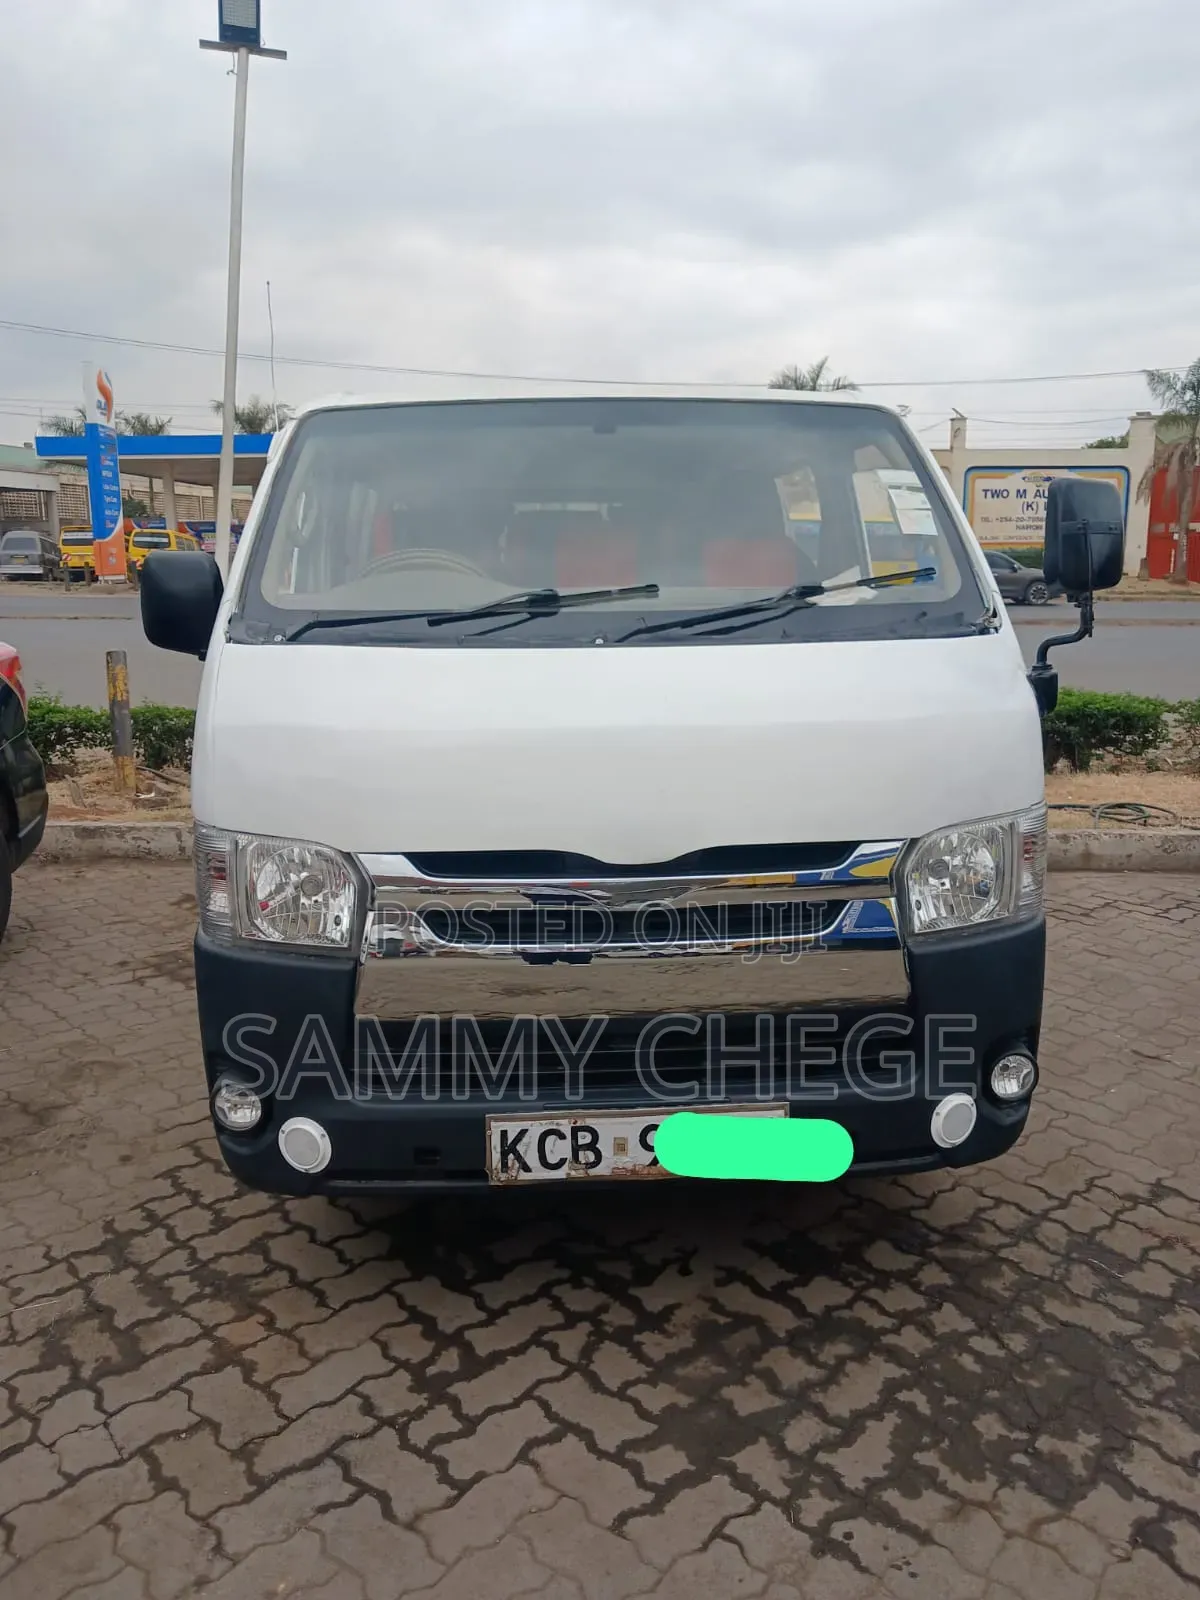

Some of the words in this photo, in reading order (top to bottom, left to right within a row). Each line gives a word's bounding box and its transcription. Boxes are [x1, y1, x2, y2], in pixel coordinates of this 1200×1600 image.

[982, 489, 1009, 499] TWO
[1016, 489, 1027, 499] M
[1034, 489, 1048, 499] AU
[1022, 501, 1039, 515] (K)
[500, 1125, 603, 1173] KCB
